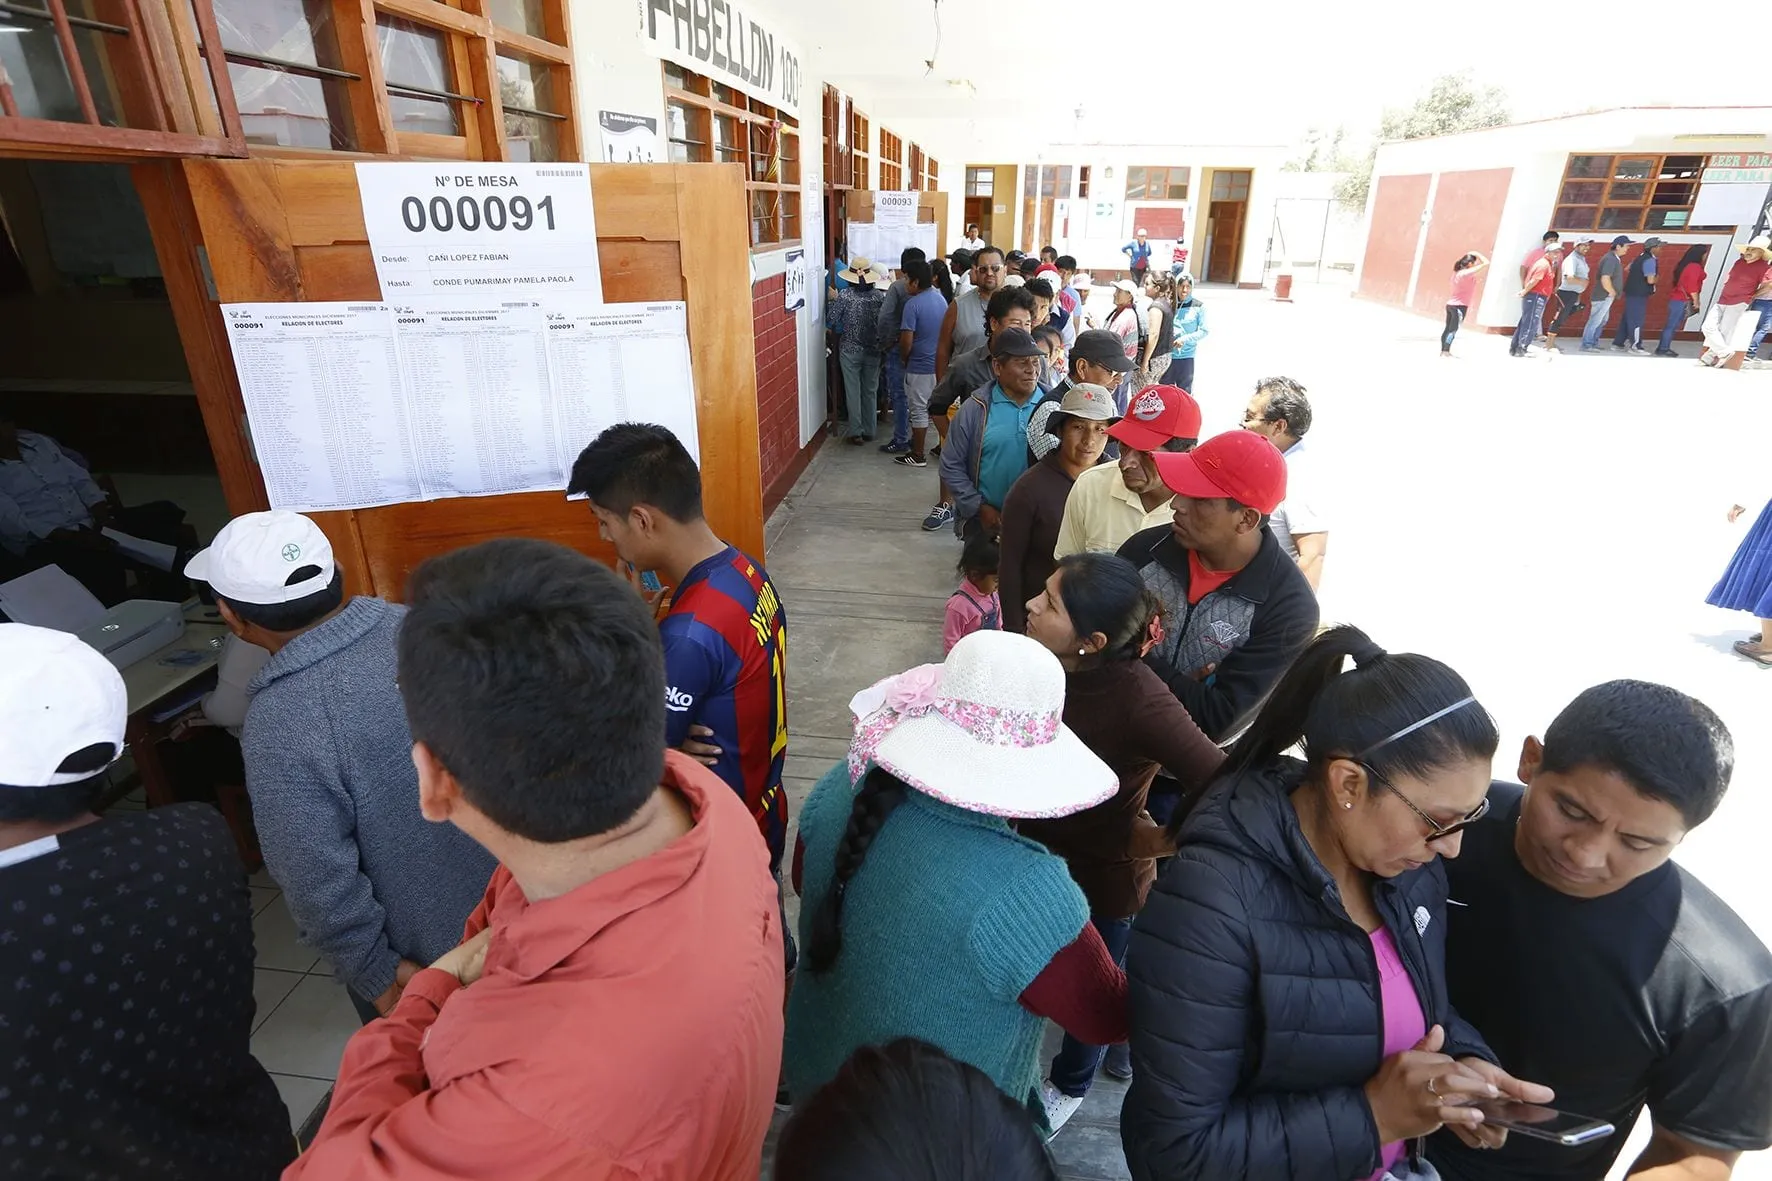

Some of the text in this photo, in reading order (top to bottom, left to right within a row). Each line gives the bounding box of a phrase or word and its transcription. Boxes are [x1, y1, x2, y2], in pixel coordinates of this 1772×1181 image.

[1711, 155, 1741, 167] LEER
[455, 175, 474, 187] DE
[478, 175, 518, 187] MESA
[881, 197, 912, 206] 000093
[401, 195, 556, 233] 000091
[382, 255, 410, 263] Desde:
[450, 254, 478, 262] LOPEZ
[479, 253, 509, 261] FABIAN
[387, 275, 575, 287] Hasta: CONDE PUMARIMAY PAMELA PAOLA
